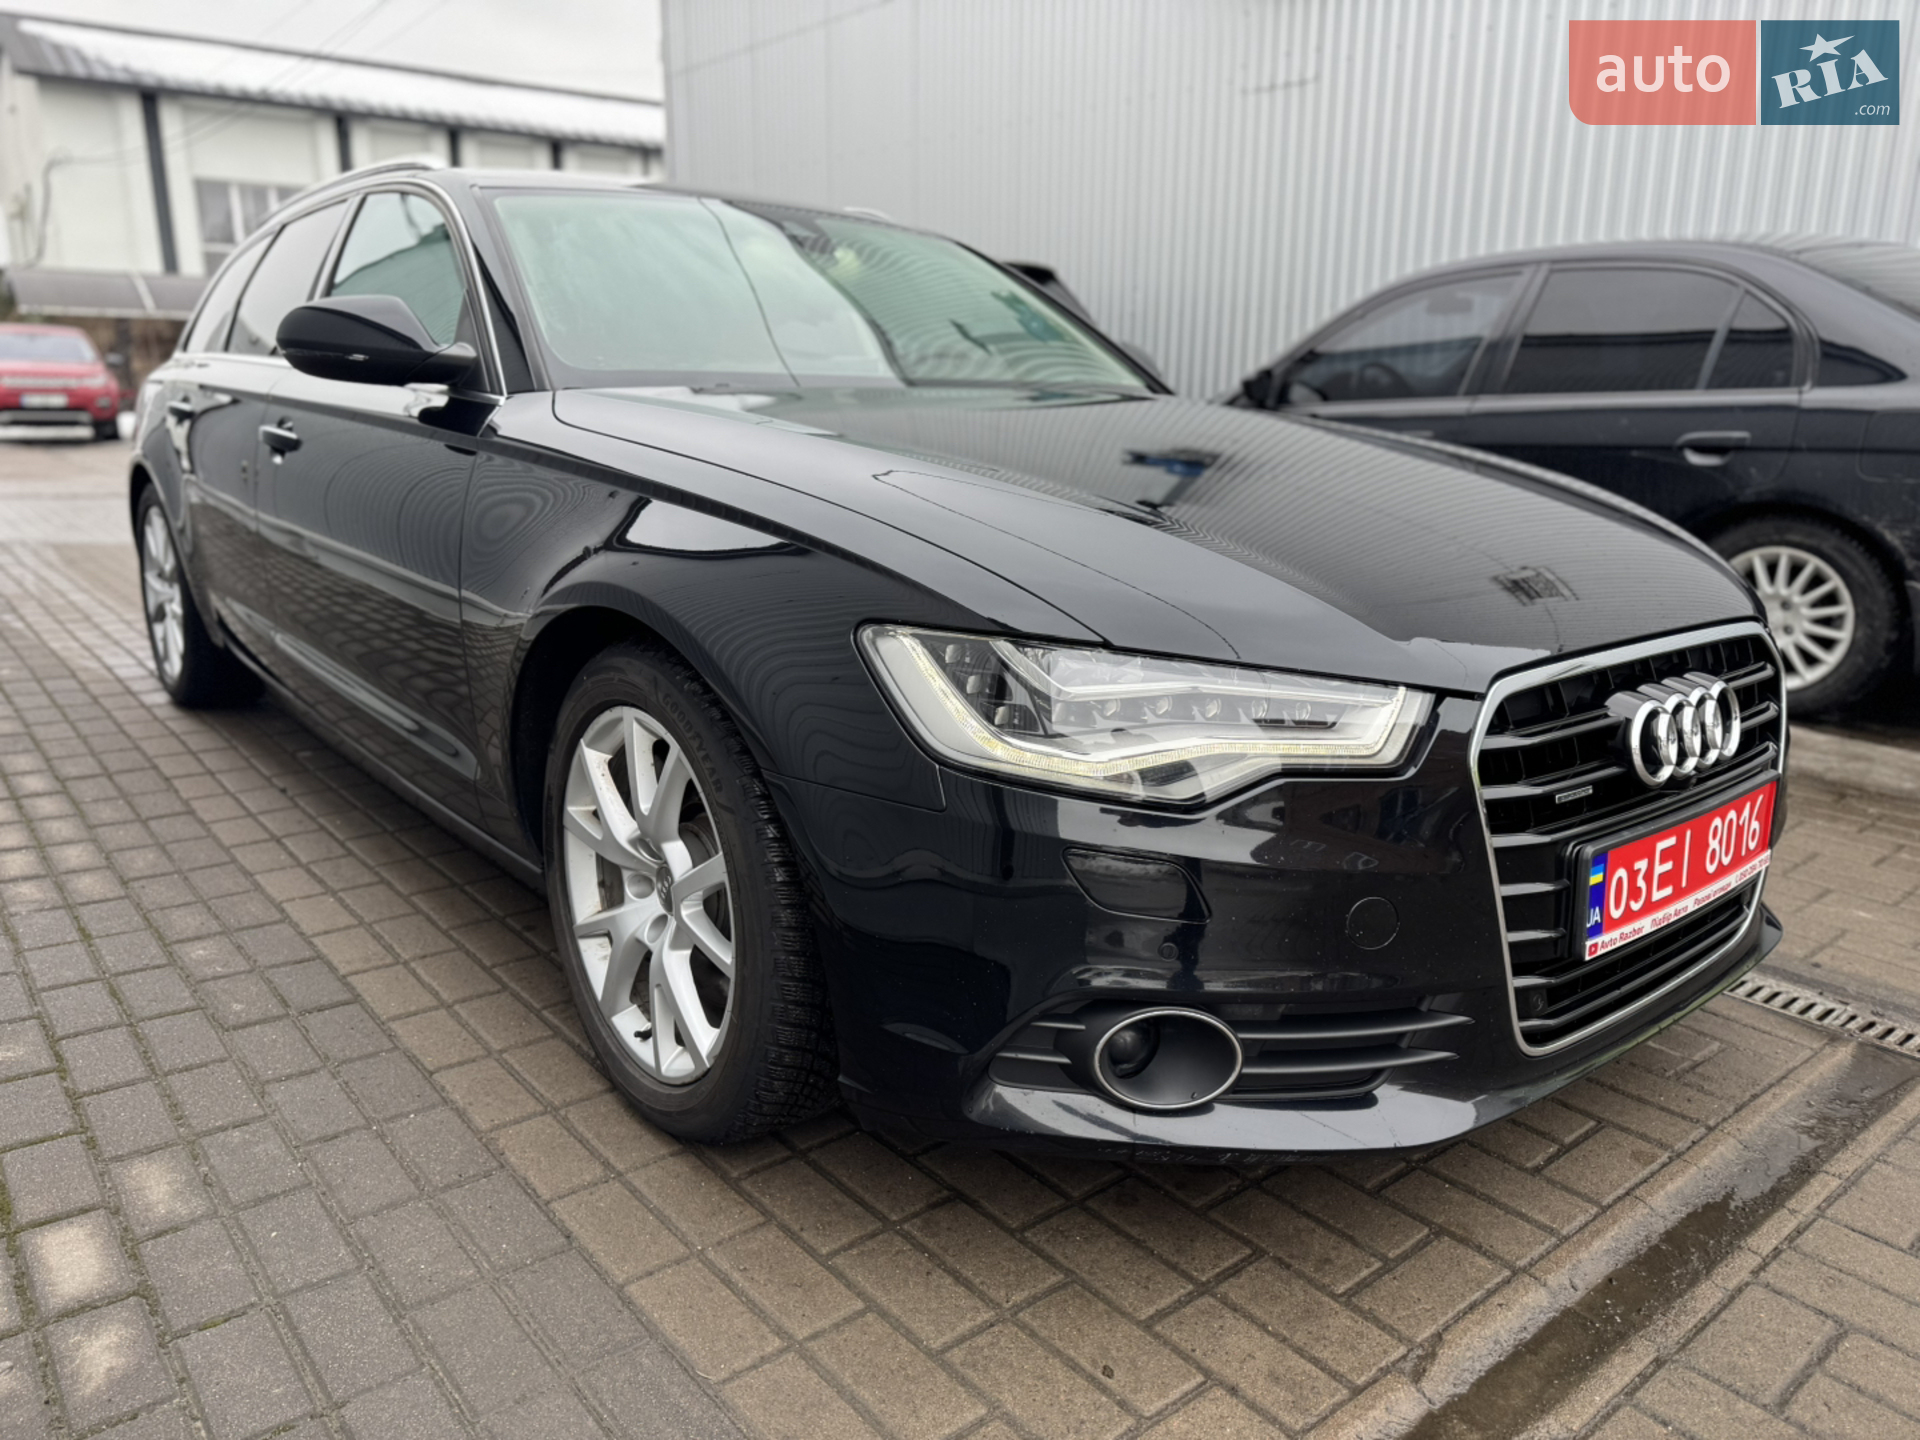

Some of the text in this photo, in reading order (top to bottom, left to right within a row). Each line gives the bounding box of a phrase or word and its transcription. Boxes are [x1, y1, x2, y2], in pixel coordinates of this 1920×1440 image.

[662, 692, 724, 793] GOODYEAR
[1706, 794, 1764, 874] 8016
[1600, 925, 1645, 951] Avto Razbor
